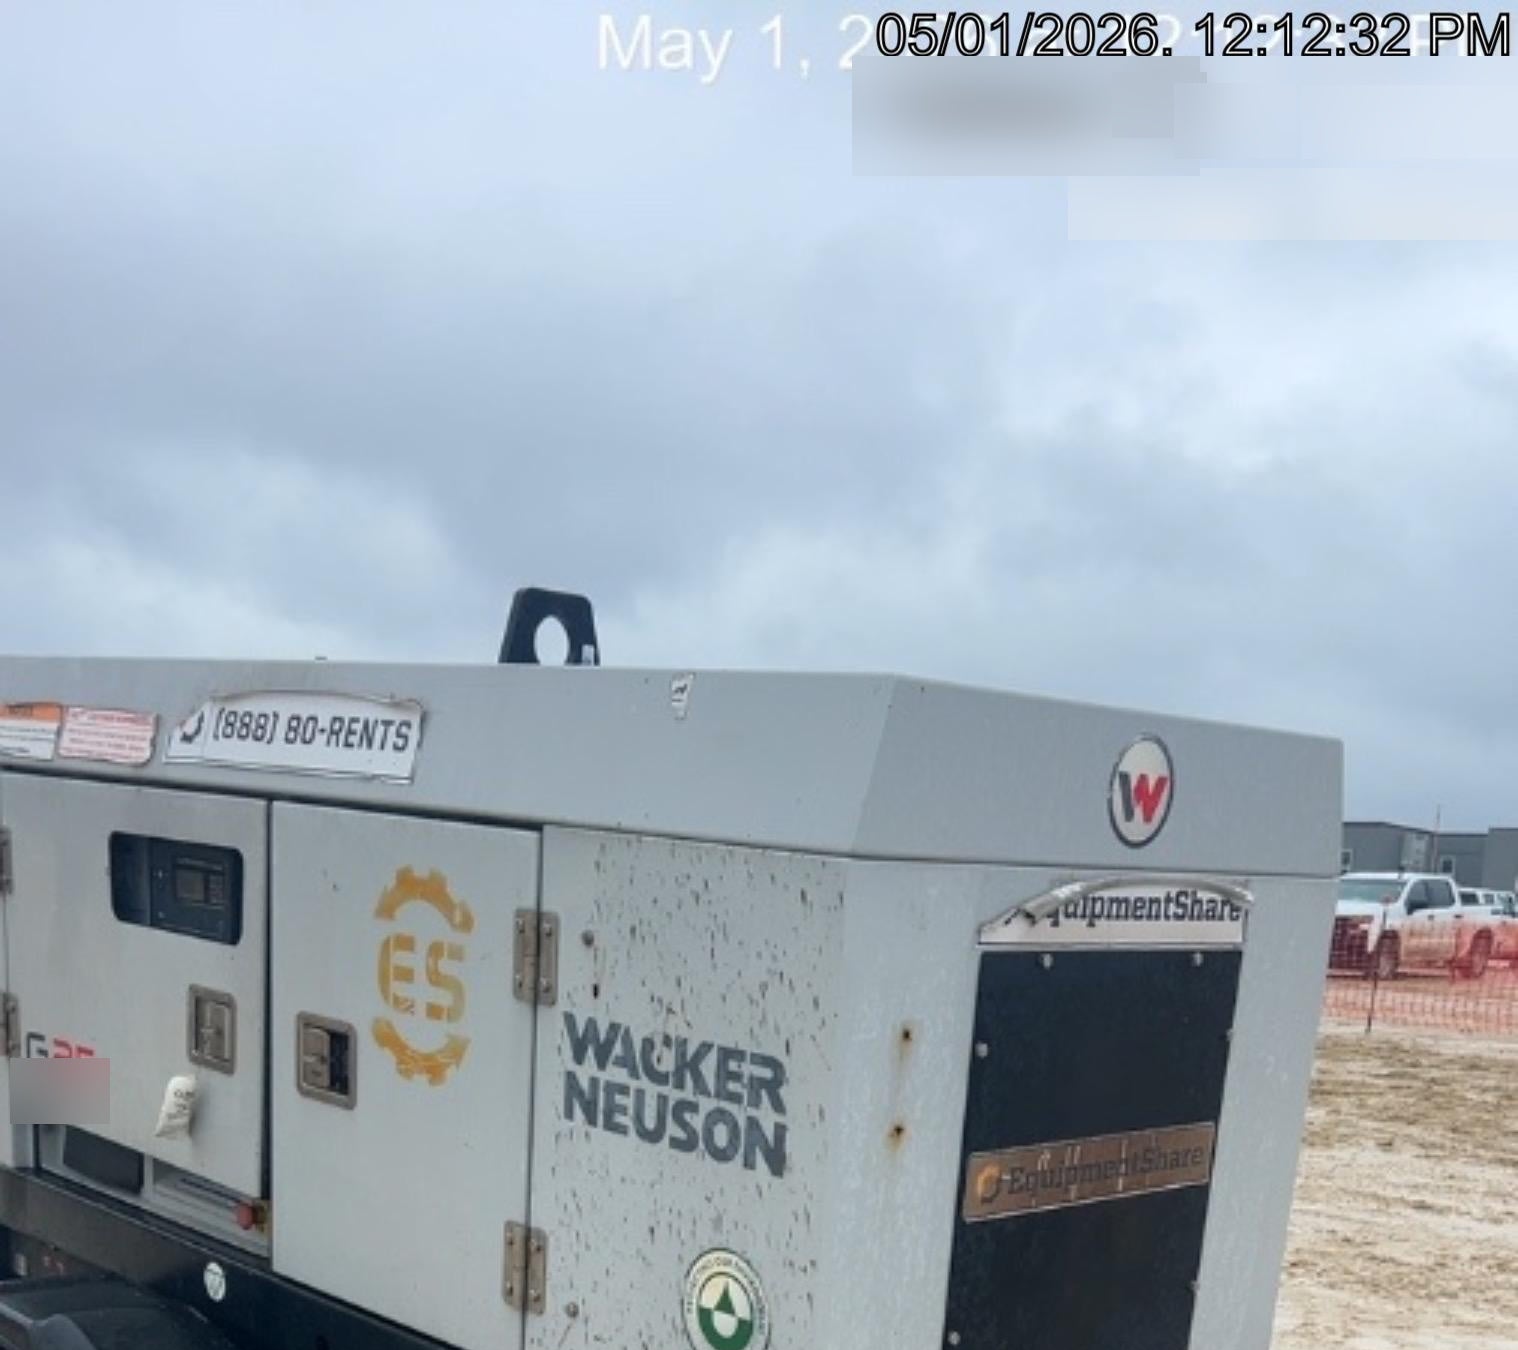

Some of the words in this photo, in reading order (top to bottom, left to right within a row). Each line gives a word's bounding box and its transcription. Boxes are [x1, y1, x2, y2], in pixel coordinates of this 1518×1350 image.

[213, 707, 279, 745] (888)
[284, 714, 412, 752] 80-RENTS
[1045, 889, 1241, 928] quipmentShare
[377, 932, 465, 1022] ES
[563, 1010, 786, 1116] WACKER
[563, 1069, 788, 1179] NEUSON
[1008, 1146, 1203, 1197] EquipmentShare
